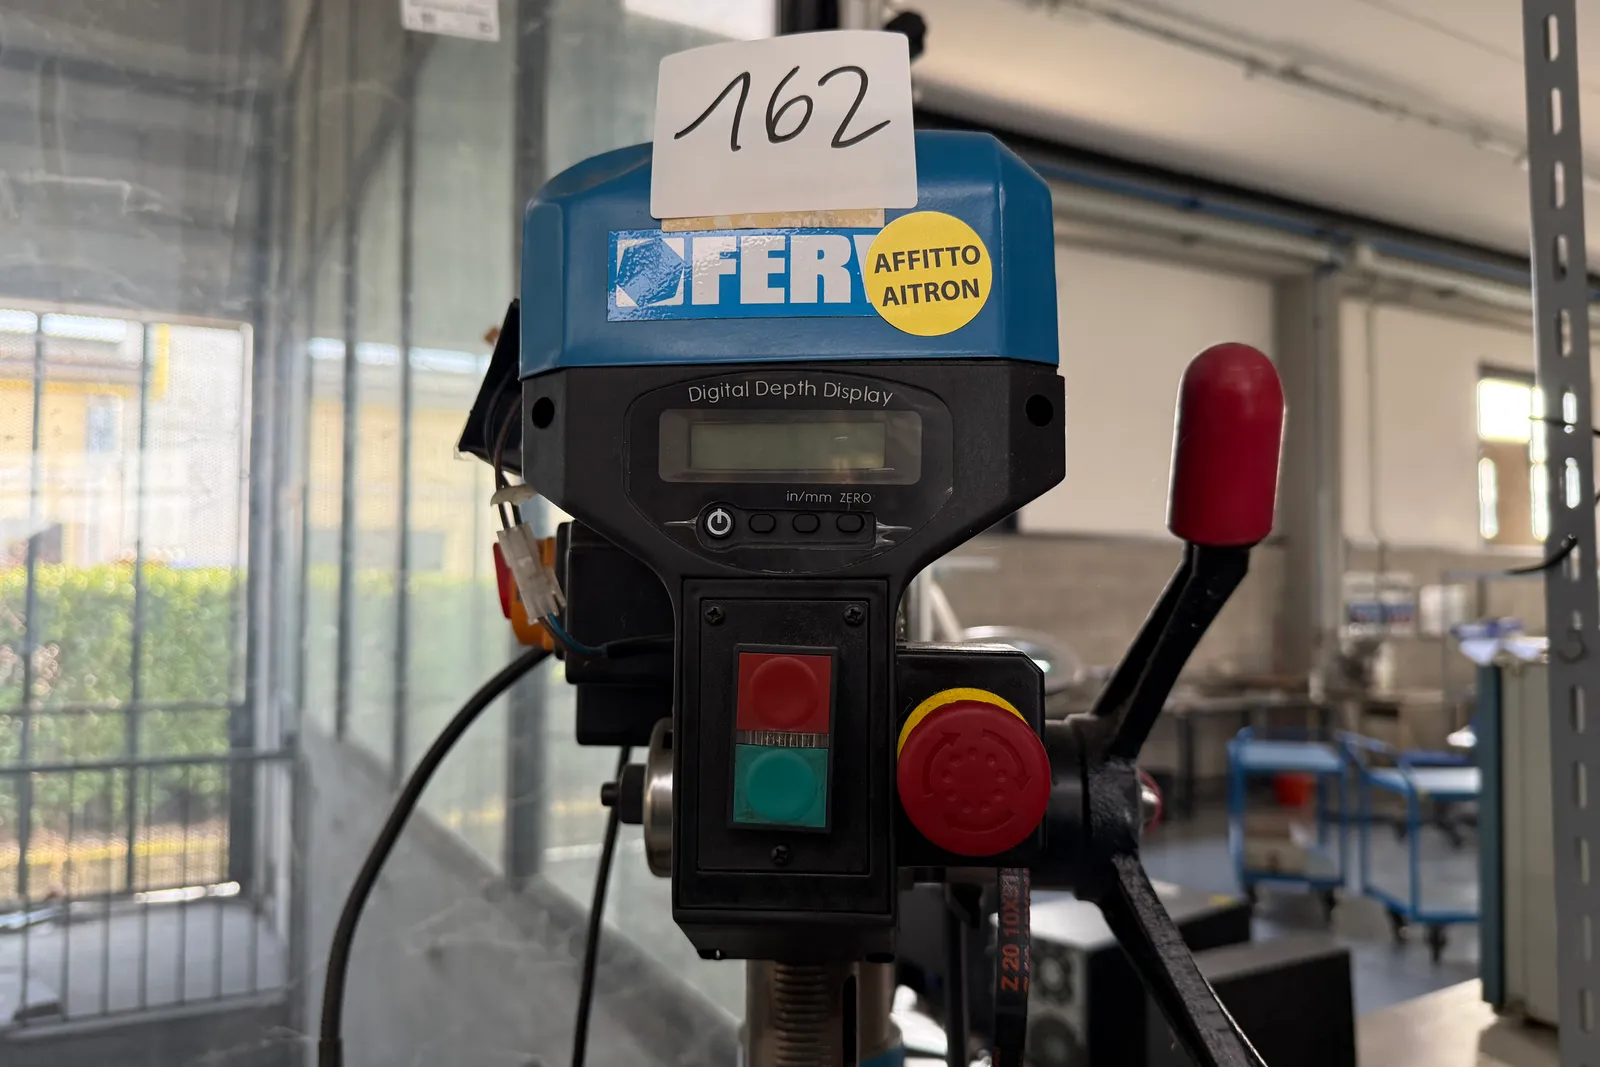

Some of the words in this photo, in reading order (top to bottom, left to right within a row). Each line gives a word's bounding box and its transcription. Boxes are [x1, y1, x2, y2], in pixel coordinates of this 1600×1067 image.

[673, 65, 891, 152] 162
[874, 245, 981, 274] AFFITTO
[882, 278, 980, 307] AITRON
[688, 381, 749, 403] Digital
[755, 380, 817, 399] Depth
[823, 382, 893, 406] Display
[786, 491, 832, 503] in/mm
[839, 492, 872, 503] ZERO
